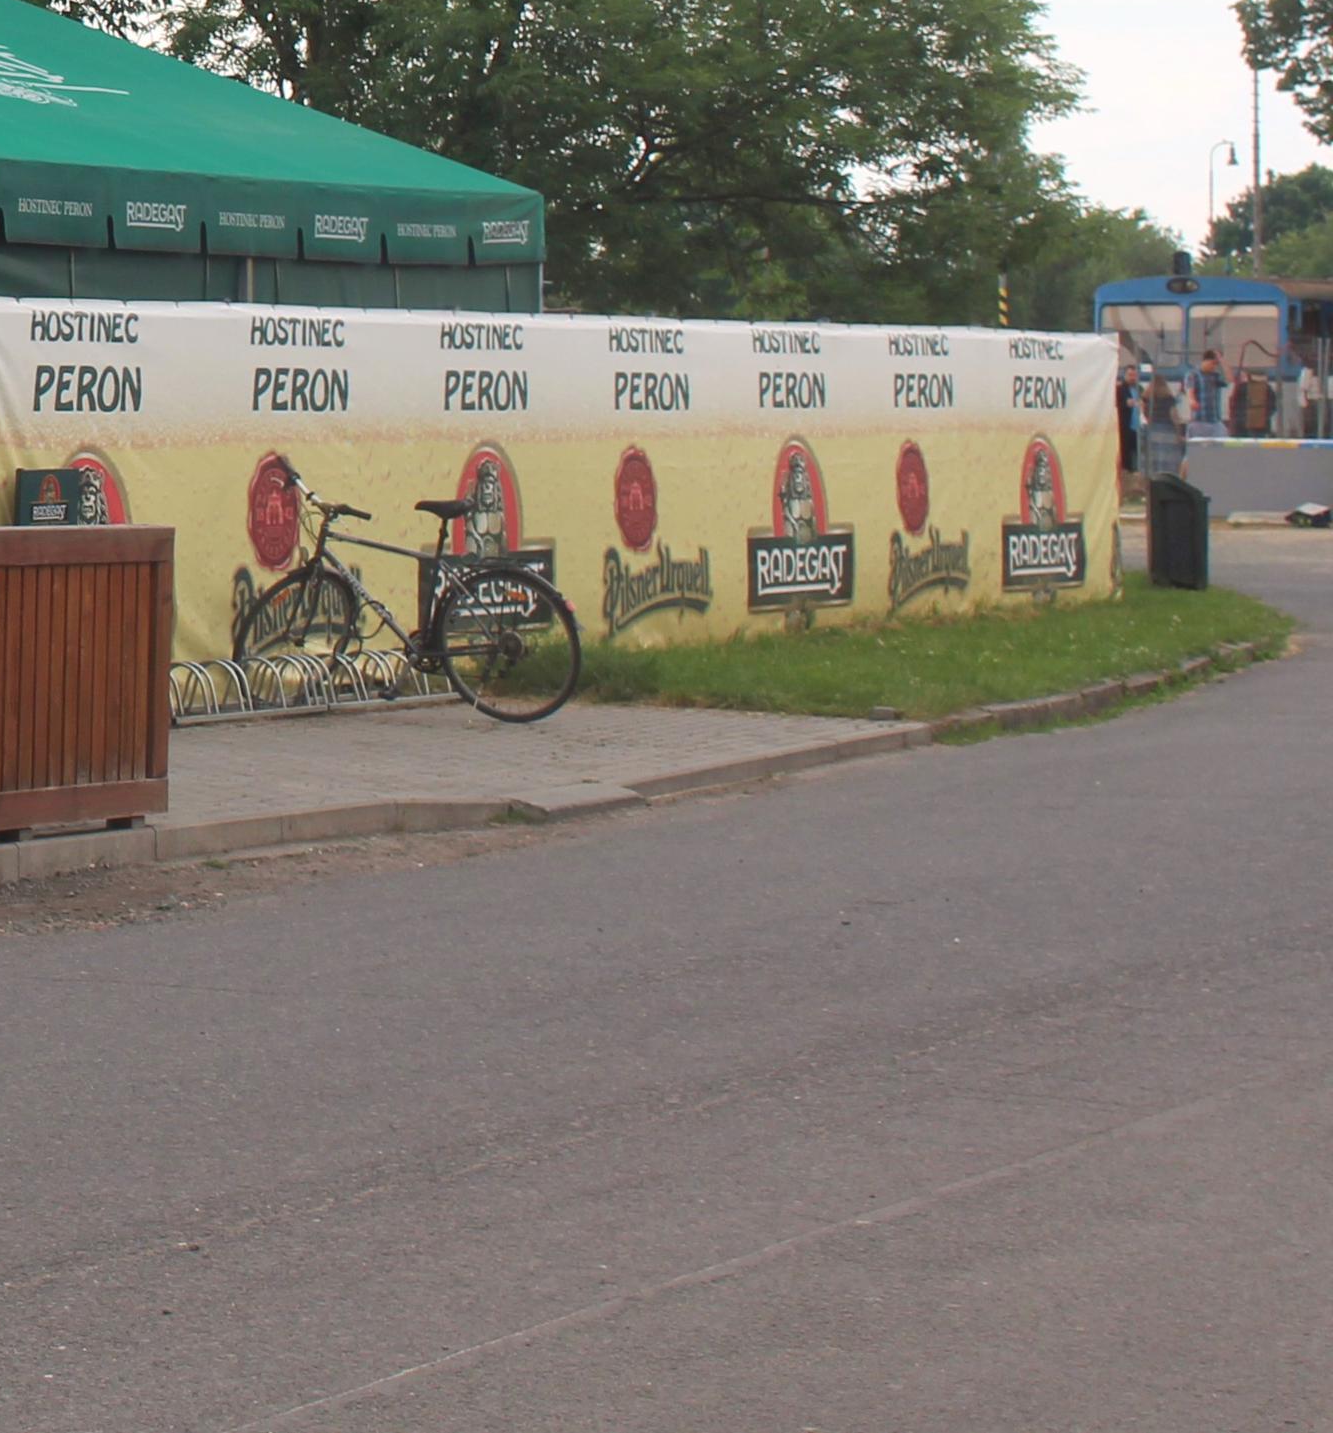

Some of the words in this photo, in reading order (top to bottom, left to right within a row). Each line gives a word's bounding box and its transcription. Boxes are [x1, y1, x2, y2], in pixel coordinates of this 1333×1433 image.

[18, 197, 62, 216] HOSTINEC
[63, 200, 94, 217] PERON
[126, 201, 187, 232] RADEGAST
[219, 211, 257, 228] HOSTINEC
[259, 214, 286, 230] PERON
[314, 214, 369, 243] RADEGAST
[482, 220, 530, 245] RADEGAST
[30, 310, 139, 344] HOSTINEC
[250, 316, 345, 348] HOSTINEC
[440, 322, 523, 351] HOSTINEC
[608, 326, 684, 355] HOSTINEC
[752, 328, 821, 355] HOSTINEC
[888, 333, 950, 357] HOSTINEC
[1009, 337, 1064, 361] HOSTINEC
[32, 365, 142, 413] PERON
[252, 367, 349, 412] PERON
[444, 370, 528, 412] PERON
[614, 371, 690, 411] PERON
[759, 371, 826, 409] PERON
[894, 373, 953, 409] PERON
[1012, 375, 1067, 410] PERON
[757, 543, 849, 596] RADEGAST
[1009, 532, 1080, 578] RADEGAST
[602, 546, 660, 639] Pilsner
